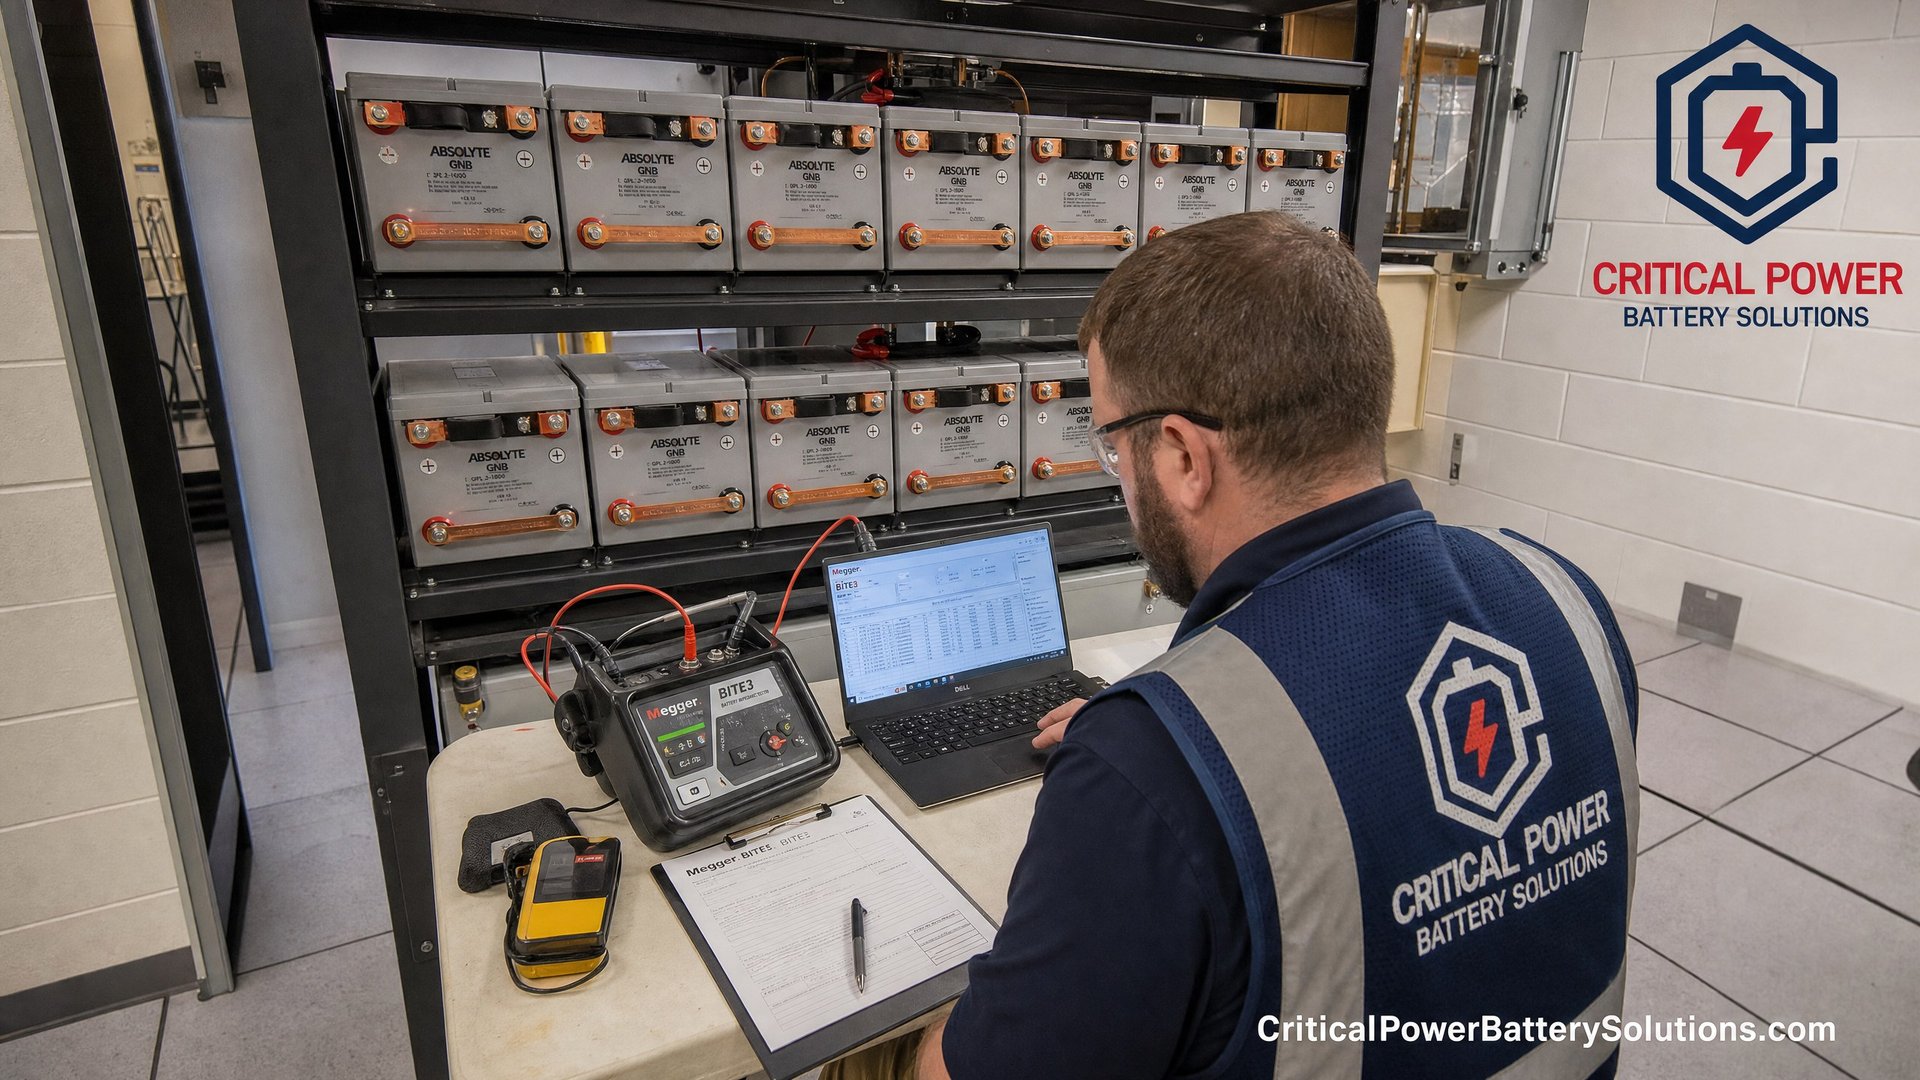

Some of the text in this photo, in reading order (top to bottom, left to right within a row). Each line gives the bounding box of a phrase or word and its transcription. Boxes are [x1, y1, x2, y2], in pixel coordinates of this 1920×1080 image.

[430, 145, 491, 159] ABSOLYTE
[621, 153, 675, 166] ABSOLYTE
[449, 160, 473, 170] GNB
[788, 160, 835, 172] ABSOLYTE
[637, 166, 659, 176] GNB
[938, 166, 980, 177] ABSOLYTE
[1067, 171, 1105, 181] ABSOLYTE
[802, 172, 821, 182] GNB
[950, 177, 968, 187] GNB
[1182, 176, 1216, 185] ABSOLYTE
[1078, 182, 1093, 191] GNB
[1285, 179, 1315, 188] ABSOLYTE
[1066, 406, 1094, 417] ABSOLY
[943, 415, 984, 427] ABSOLYTE
[805, 425, 851, 438] ABSOLYTE
[955, 425, 972, 434] GNB
[651, 436, 701, 449] ABSOLYTE
[818, 437, 837, 446] GNB
[468, 449, 526, 464] ABSOLYTE
[666, 448, 686, 458] GNB
[486, 462, 509, 472] GNB
[832, 566, 862, 576] Megger.
[718, 679, 754, 699] BITE3
[955, 684, 971, 693] DELL
[646, 697, 703, 720] Megger.
[1392, 789, 1612, 925] CRITICAL POWER
[686, 855, 740, 877] Megger.
[1416, 840, 1609, 957] BATTERY SOLUTIONS
